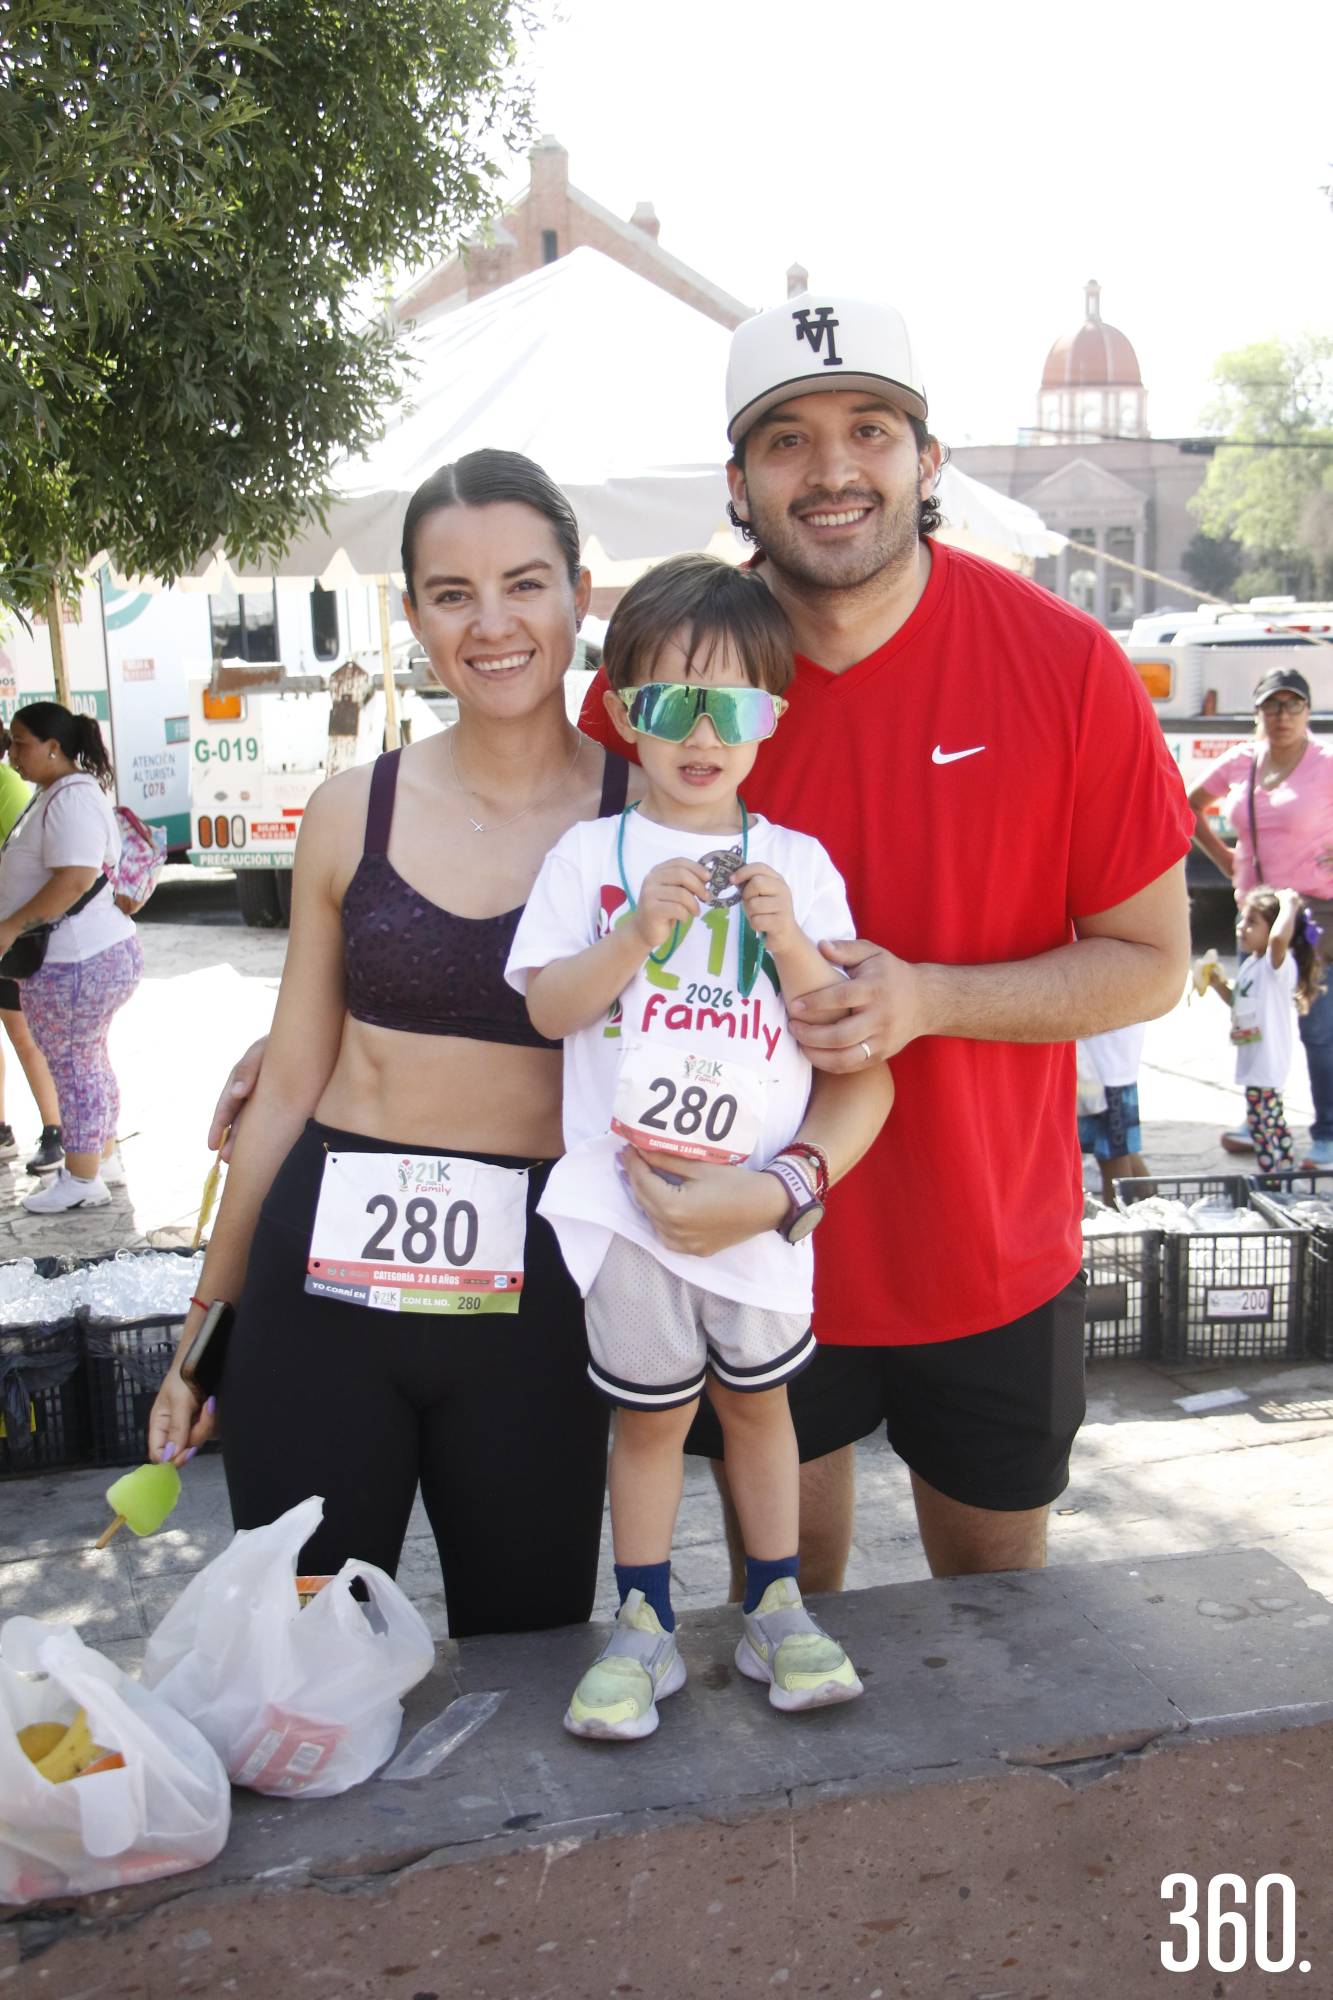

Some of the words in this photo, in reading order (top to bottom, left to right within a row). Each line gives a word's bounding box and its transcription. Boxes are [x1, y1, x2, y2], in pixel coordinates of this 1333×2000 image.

[195, 737, 258, 763] G-019
[133, 771, 144, 782] AL
[145, 766, 176, 781] TURISTA
[686, 983, 733, 1008] 2026
[638, 1077, 738, 1142] 280
[415, 1160, 451, 1183] 21K
[361, 1194, 479, 1267] 280
[373, 1270, 415, 1283] CATEGORÍA
[418, 1274, 424, 1282] 2
[425, 1274, 431, 1282] A
[439, 1274, 460, 1285] AÑOS
[312, 1282, 325, 1290] YO
[353, 1290, 366, 1299] EN
[402, 1296, 421, 1304] CON
[423, 1297, 433, 1305] EL
[458, 1297, 481, 1310] 280
[1241, 1291, 1266, 1310] 200
